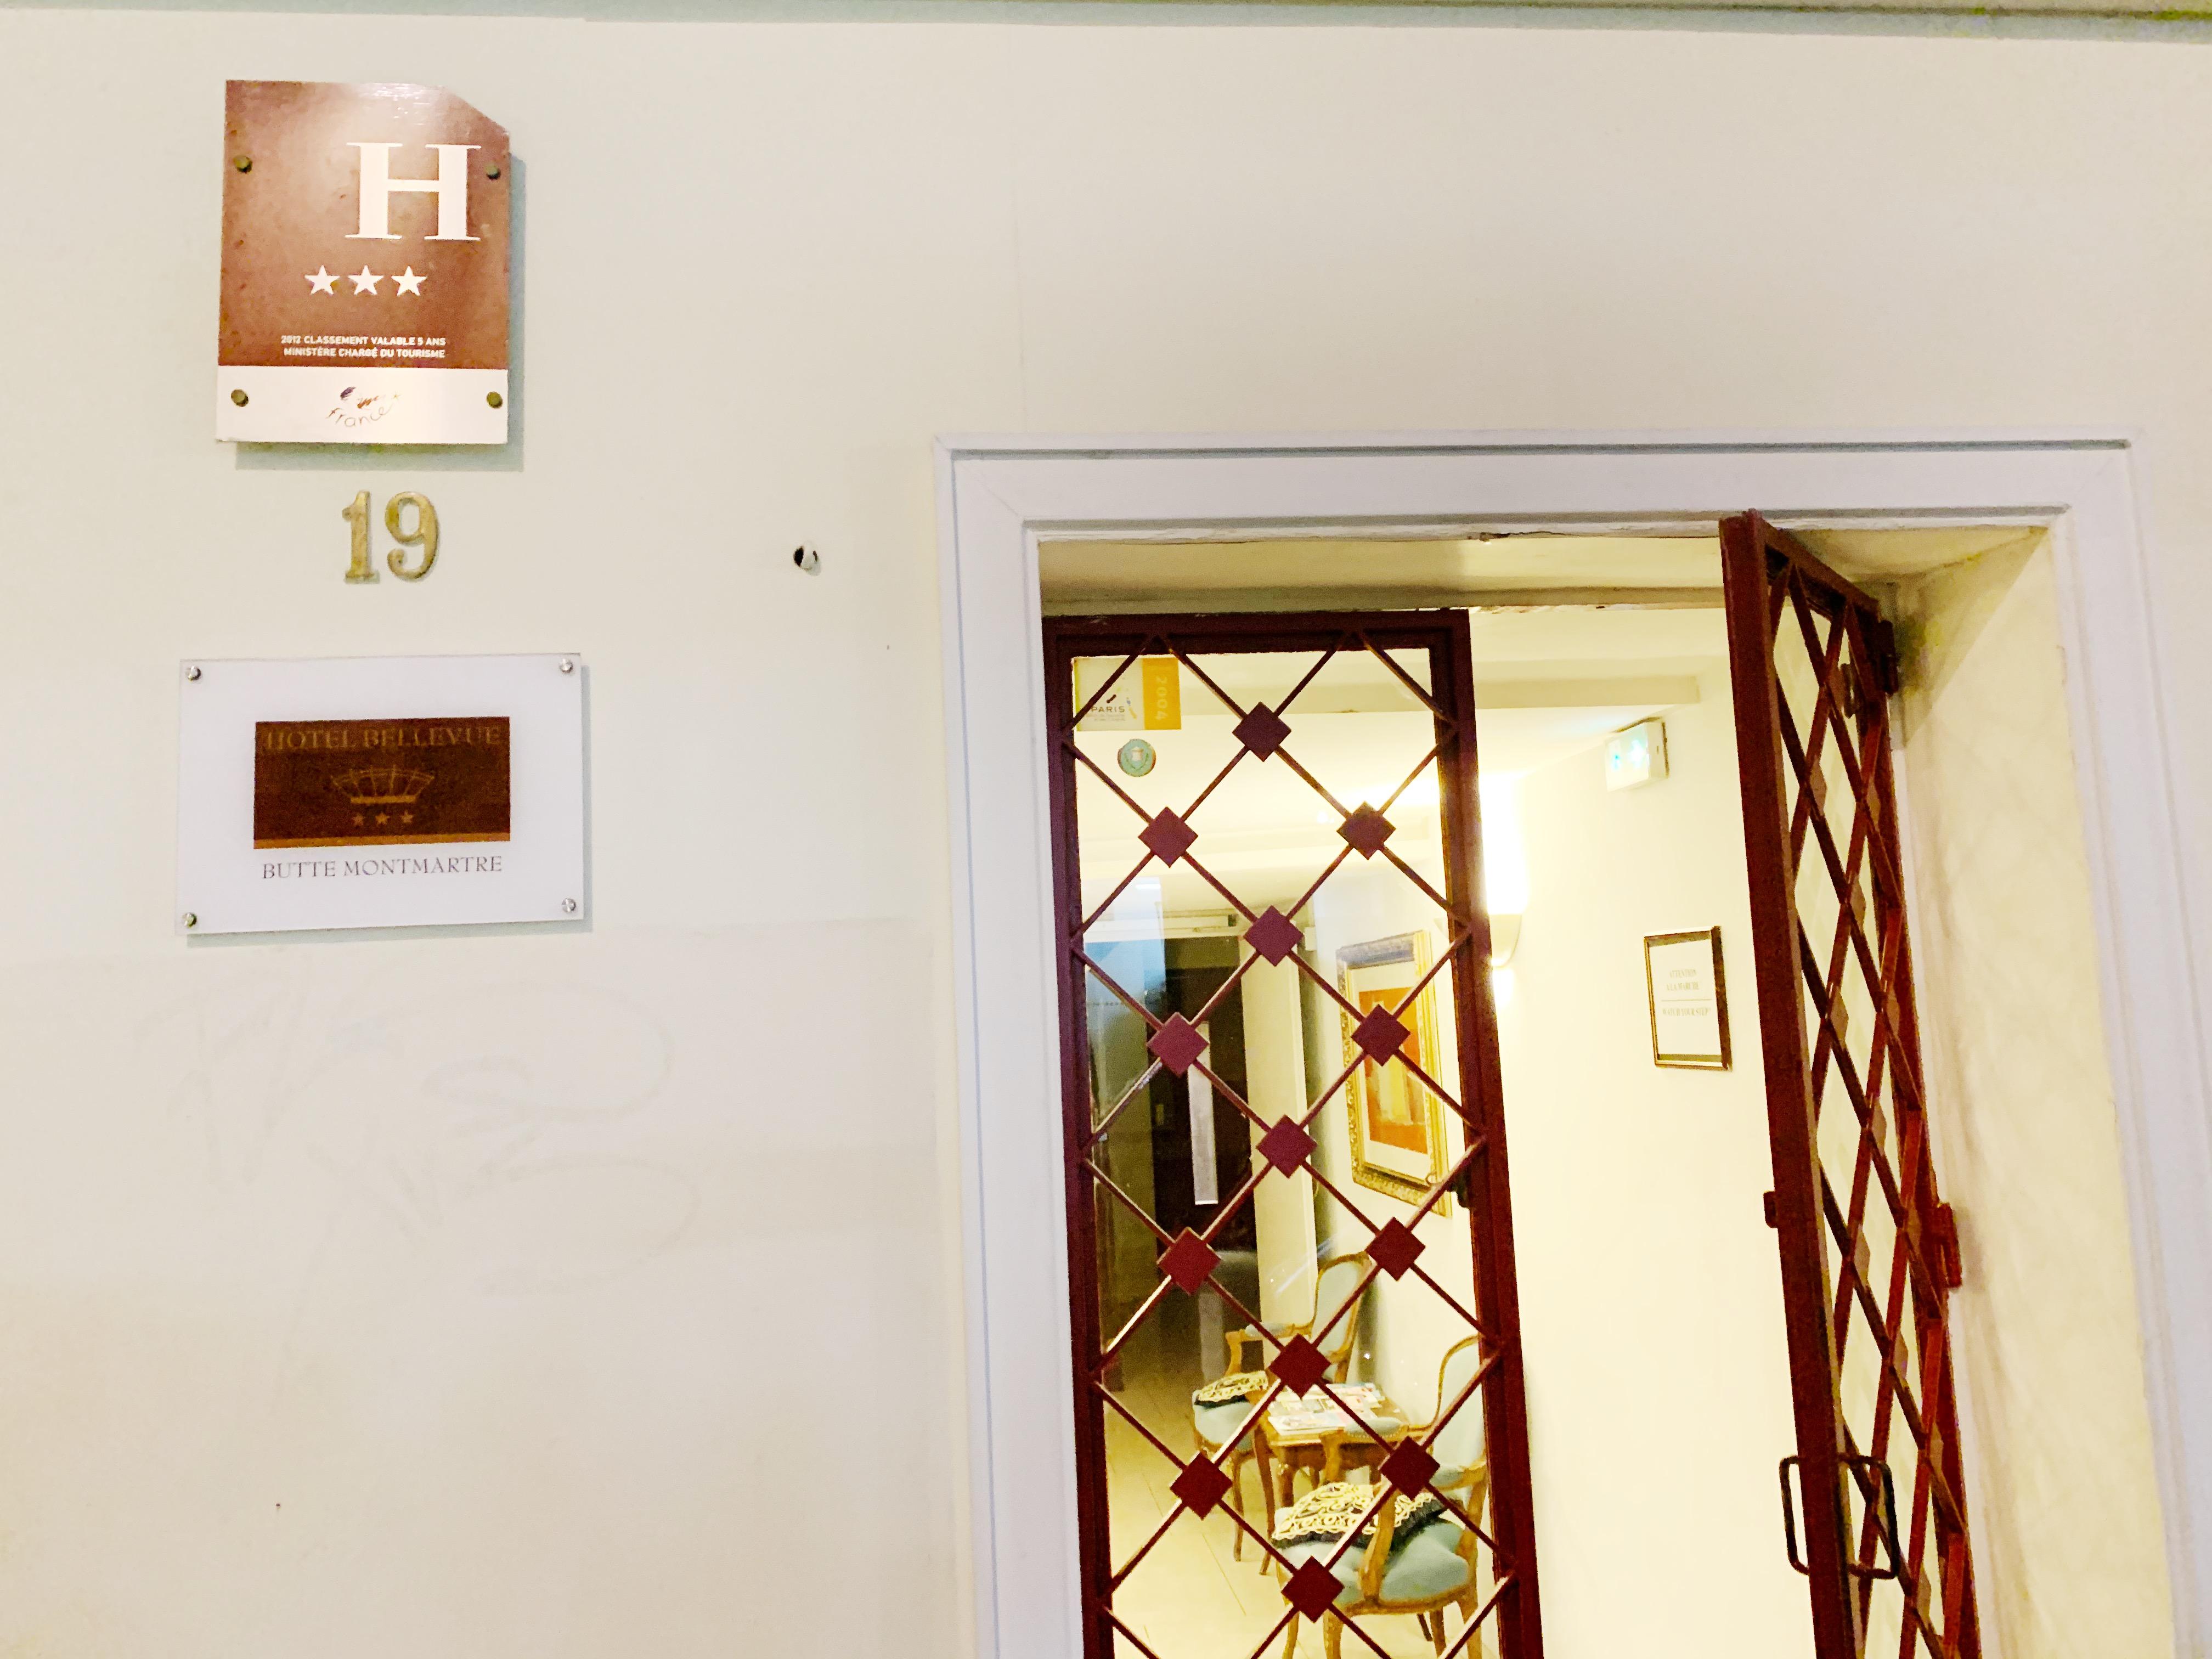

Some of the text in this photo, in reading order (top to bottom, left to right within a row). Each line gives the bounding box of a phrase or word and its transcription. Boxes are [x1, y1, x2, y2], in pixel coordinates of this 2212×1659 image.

[345, 142, 481, 240] H
[284, 346, 336, 357] MINISTÈRE
[338, 347, 378, 357] CHARGÉ
[396, 349, 445, 358] TOURISME
[303, 336, 368, 345] CLASSEMENT
[371, 336, 415, 346] VALABLE
[426, 337, 446, 346] ANS
[342, 490, 439, 583] 19
[263, 725, 501, 751] HOTEL BELLEVUE
[263, 855, 503, 878] BUTTE MONTMARTRE
